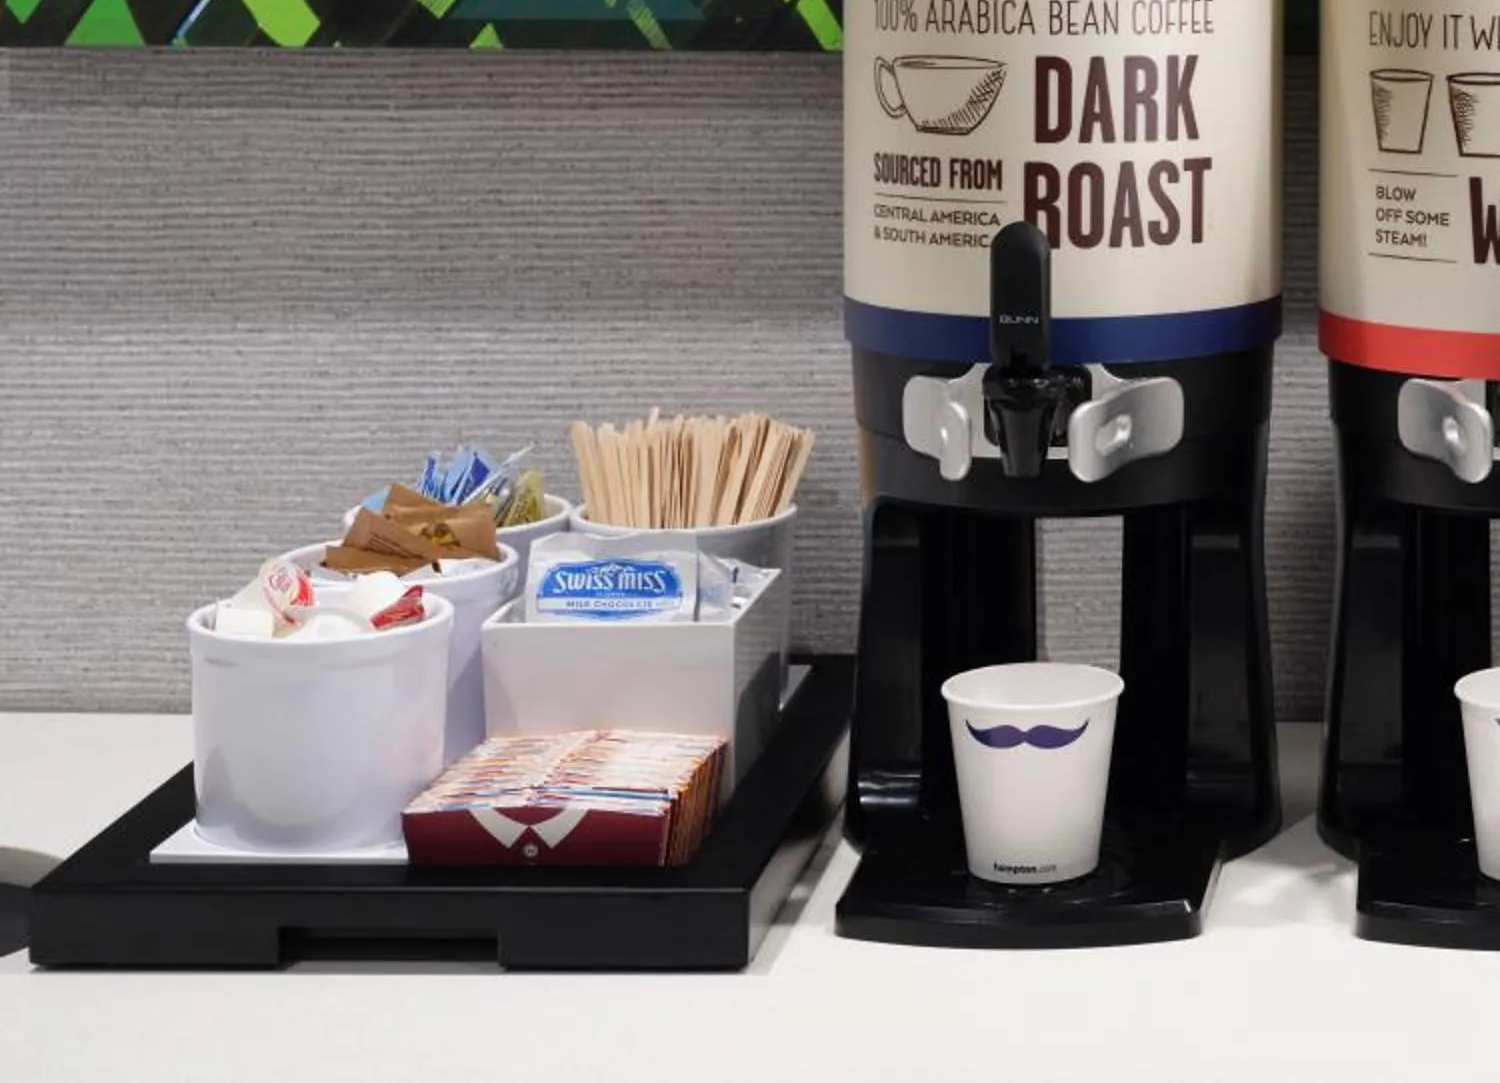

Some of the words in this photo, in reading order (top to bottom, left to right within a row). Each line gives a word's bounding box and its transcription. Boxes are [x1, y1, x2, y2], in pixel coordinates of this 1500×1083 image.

[1368, 10, 1433, 49] ENJOY
[1443, 13, 1463, 50] IT
[1034, 55, 1200, 143] DARK
[873, 152, 942, 189] SOURCED
[949, 157, 1003, 192] FROM
[1023, 157, 1213, 250] ROAST
[1375, 184, 1417, 202] BLOW
[873, 203, 928, 223] CENTRAL
[929, 210, 1001, 227] AMERICA
[1375, 207, 1402, 222] OFF
[1405, 210, 1451, 226] SOME
[882, 226, 926, 245] SOUTH
[928, 231, 992, 249] AMERIC
[999, 315, 1039, 325] BUNN
